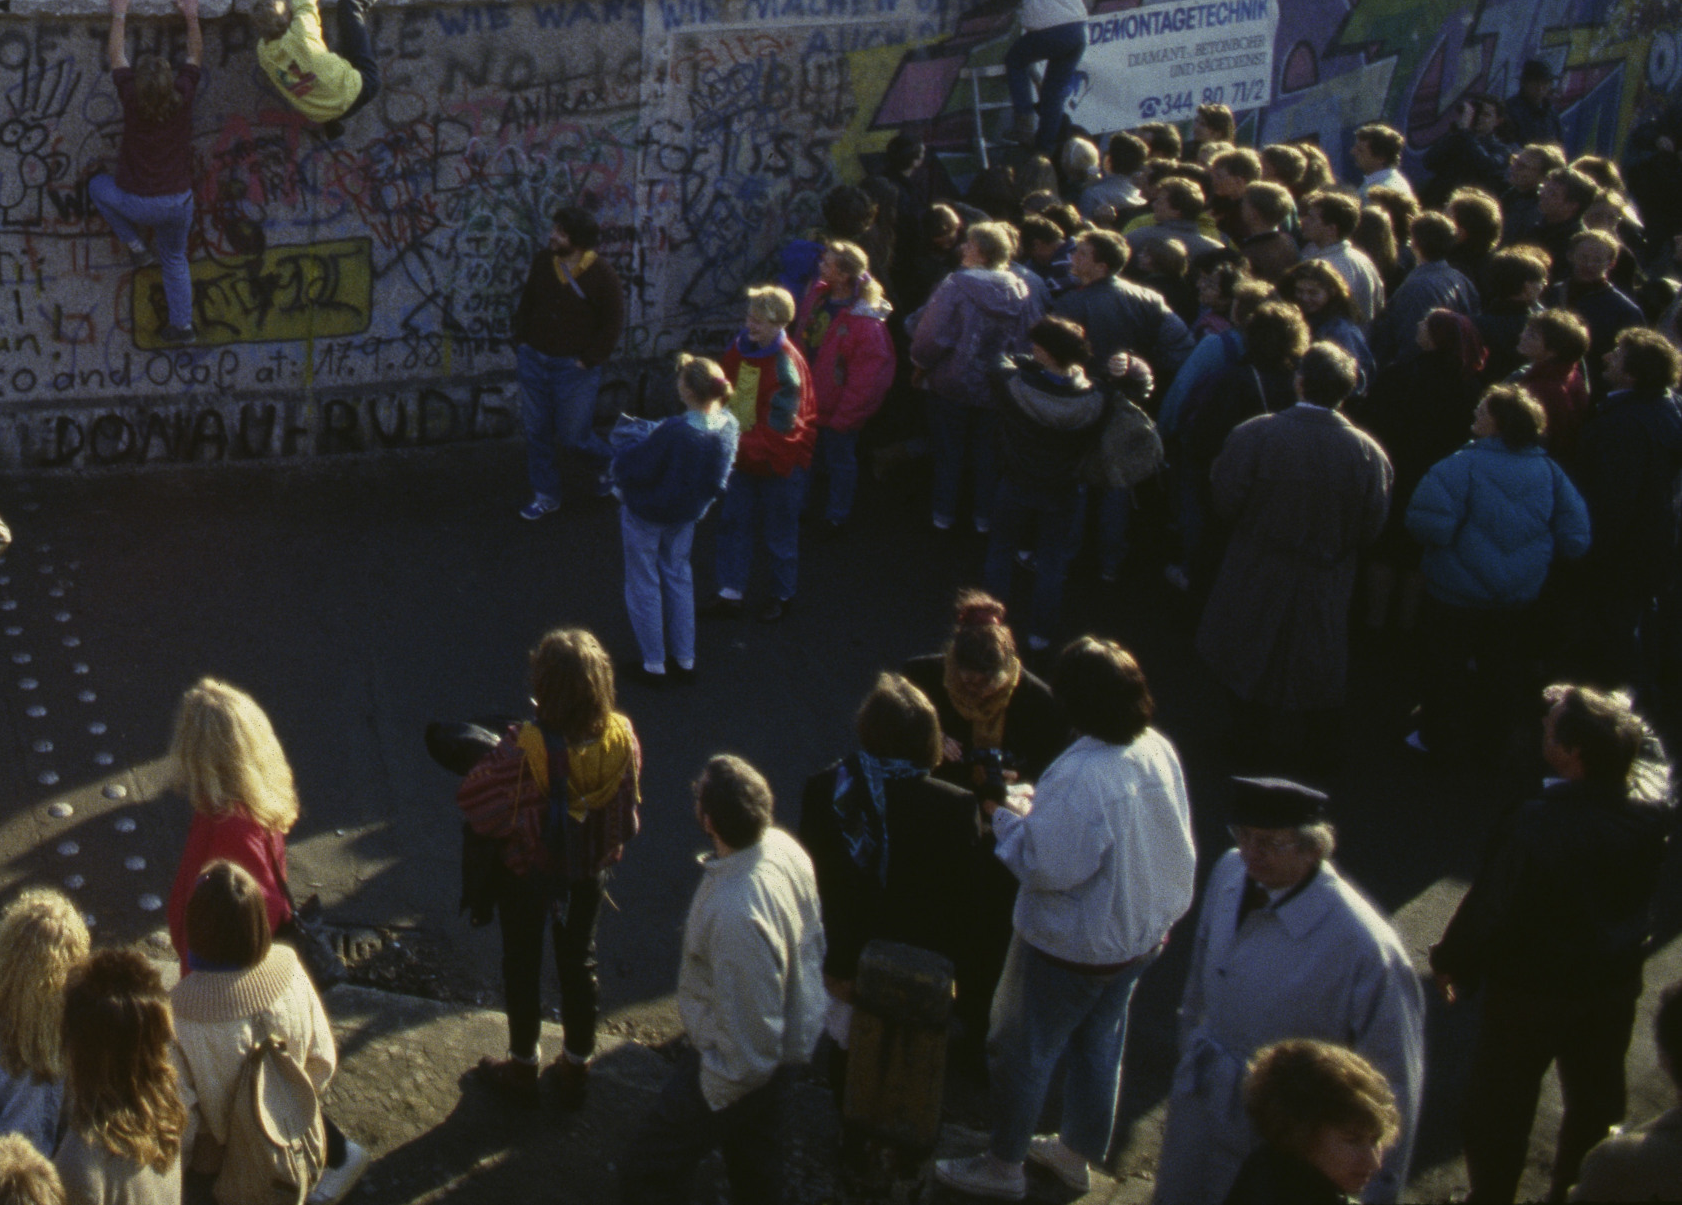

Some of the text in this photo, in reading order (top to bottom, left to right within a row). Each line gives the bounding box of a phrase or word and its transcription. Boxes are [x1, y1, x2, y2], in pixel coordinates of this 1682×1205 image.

[1160, 78, 1265, 117] 344 80 71/2
[53, 351, 131, 392] and
